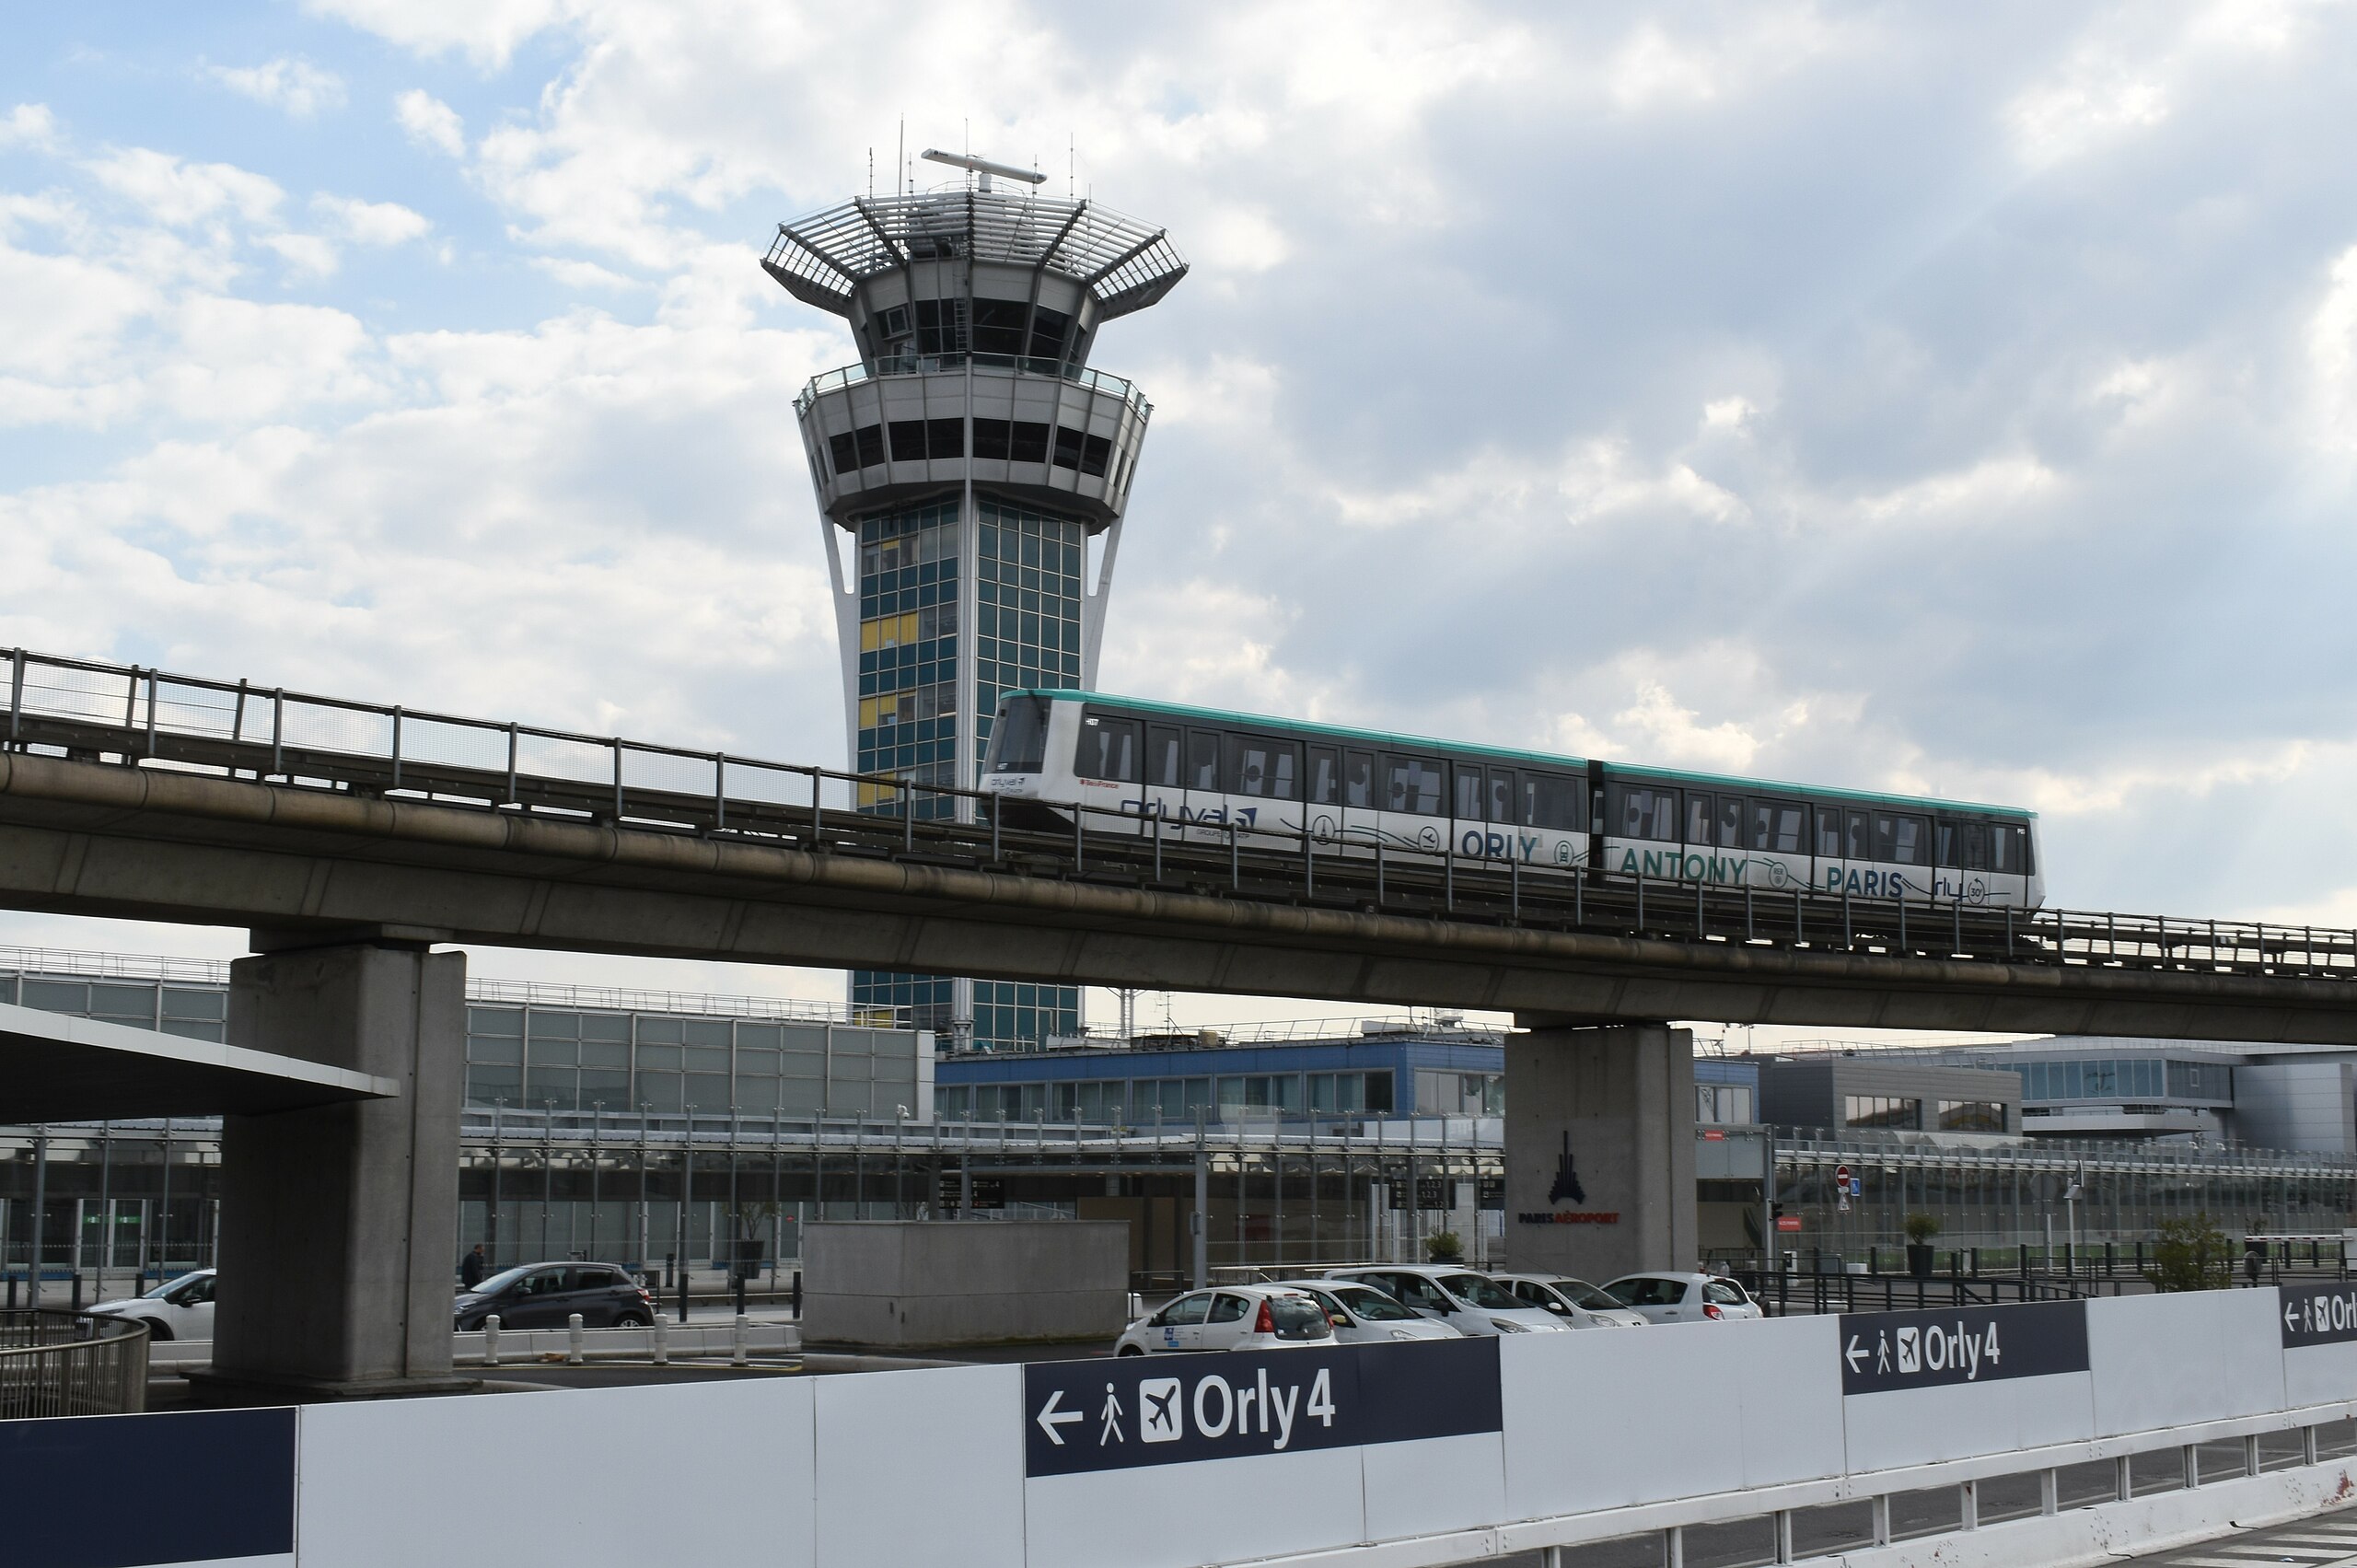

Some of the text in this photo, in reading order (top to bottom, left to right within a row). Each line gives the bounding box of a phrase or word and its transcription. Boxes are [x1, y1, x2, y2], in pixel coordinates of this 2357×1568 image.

[1462, 830, 1538, 864] ORLY
[1620, 848, 1747, 885] ANTONY
[1827, 866, 1903, 898] PARIS
[1518, 1213, 1554, 1224] PARIS
[2331, 1292, 2357, 1330] Orl
[1924, 1320, 2001, 1380] Orly 4
[1193, 1367, 1336, 1450] Orly 4
